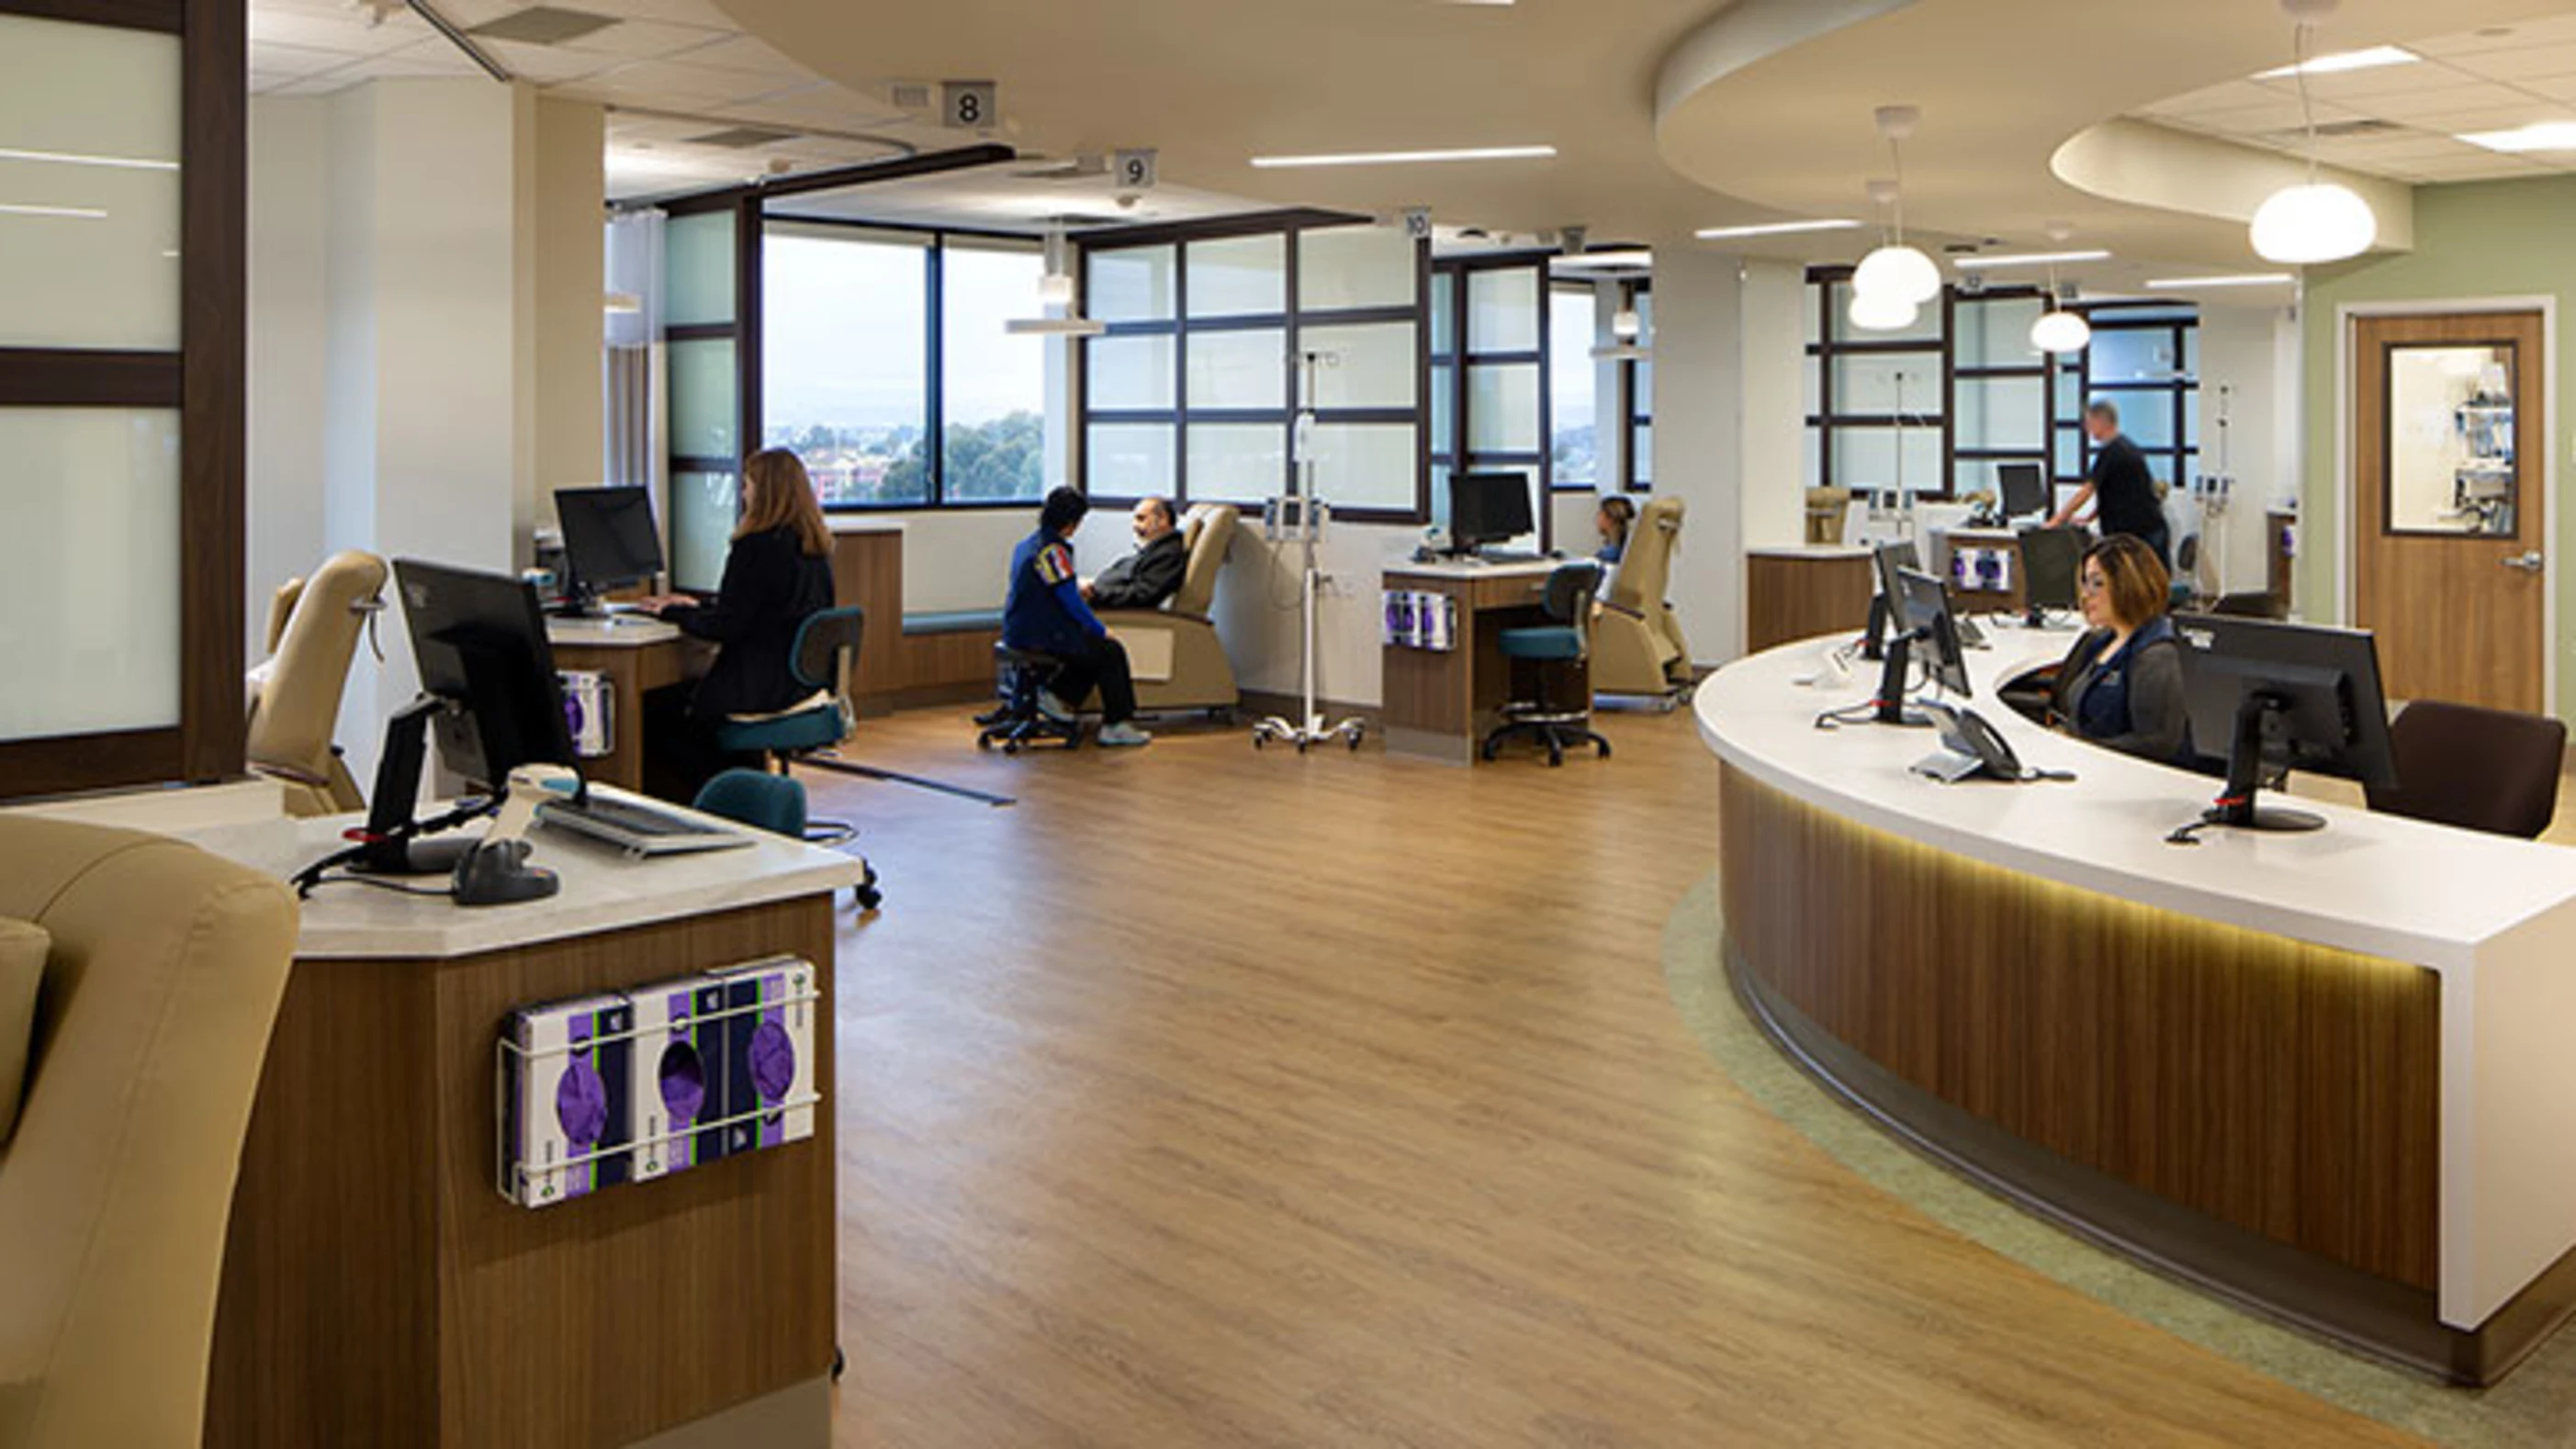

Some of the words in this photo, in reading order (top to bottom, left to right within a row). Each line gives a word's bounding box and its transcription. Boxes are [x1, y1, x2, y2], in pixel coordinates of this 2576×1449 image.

[959, 94, 979, 122] 8
[1127, 159, 1144, 185] 9
[1407, 215, 1425, 235] 10
